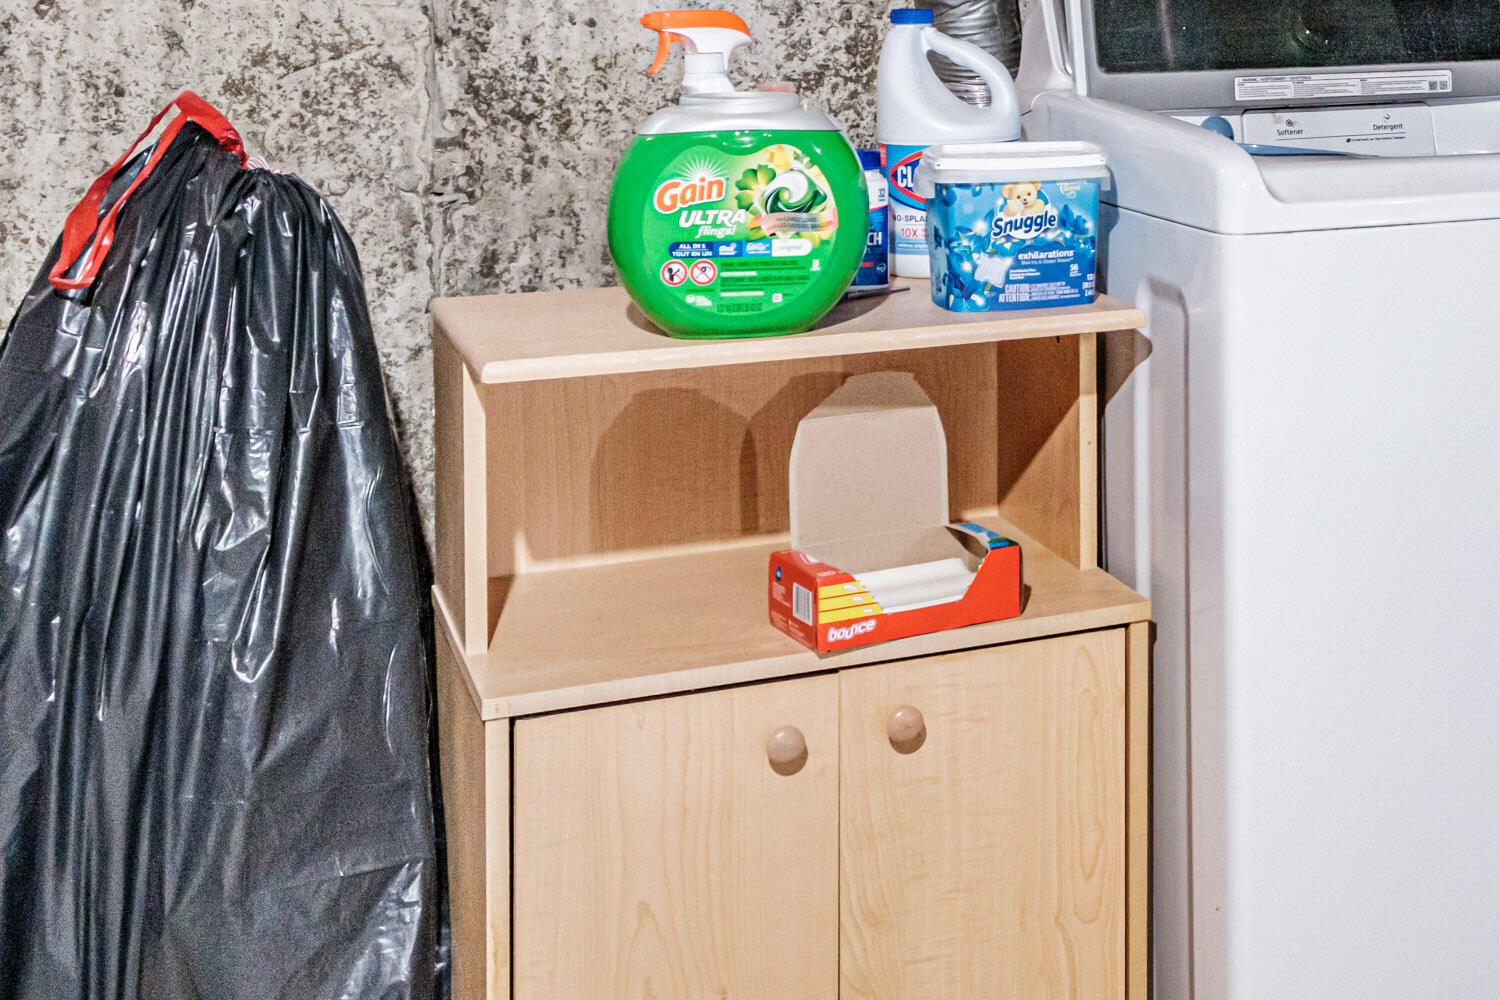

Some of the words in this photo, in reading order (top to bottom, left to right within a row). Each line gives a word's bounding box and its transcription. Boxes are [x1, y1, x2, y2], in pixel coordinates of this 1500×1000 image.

[1276, 128, 1303, 136] Softener
[1372, 123, 1403, 132] Detergent
[897, 165, 914, 188] CL
[655, 176, 725, 212] Gain
[679, 209, 746, 228] ULTRA
[893, 214, 927, 222] NO-SPLA
[993, 211, 1057, 237] Snuggle
[695, 225, 736, 239] flings!
[868, 231, 882, 246] CH
[901, 228, 918, 238] 10X
[1018, 250, 1074, 260] exhilarations
[828, 619, 877, 642] bounce
